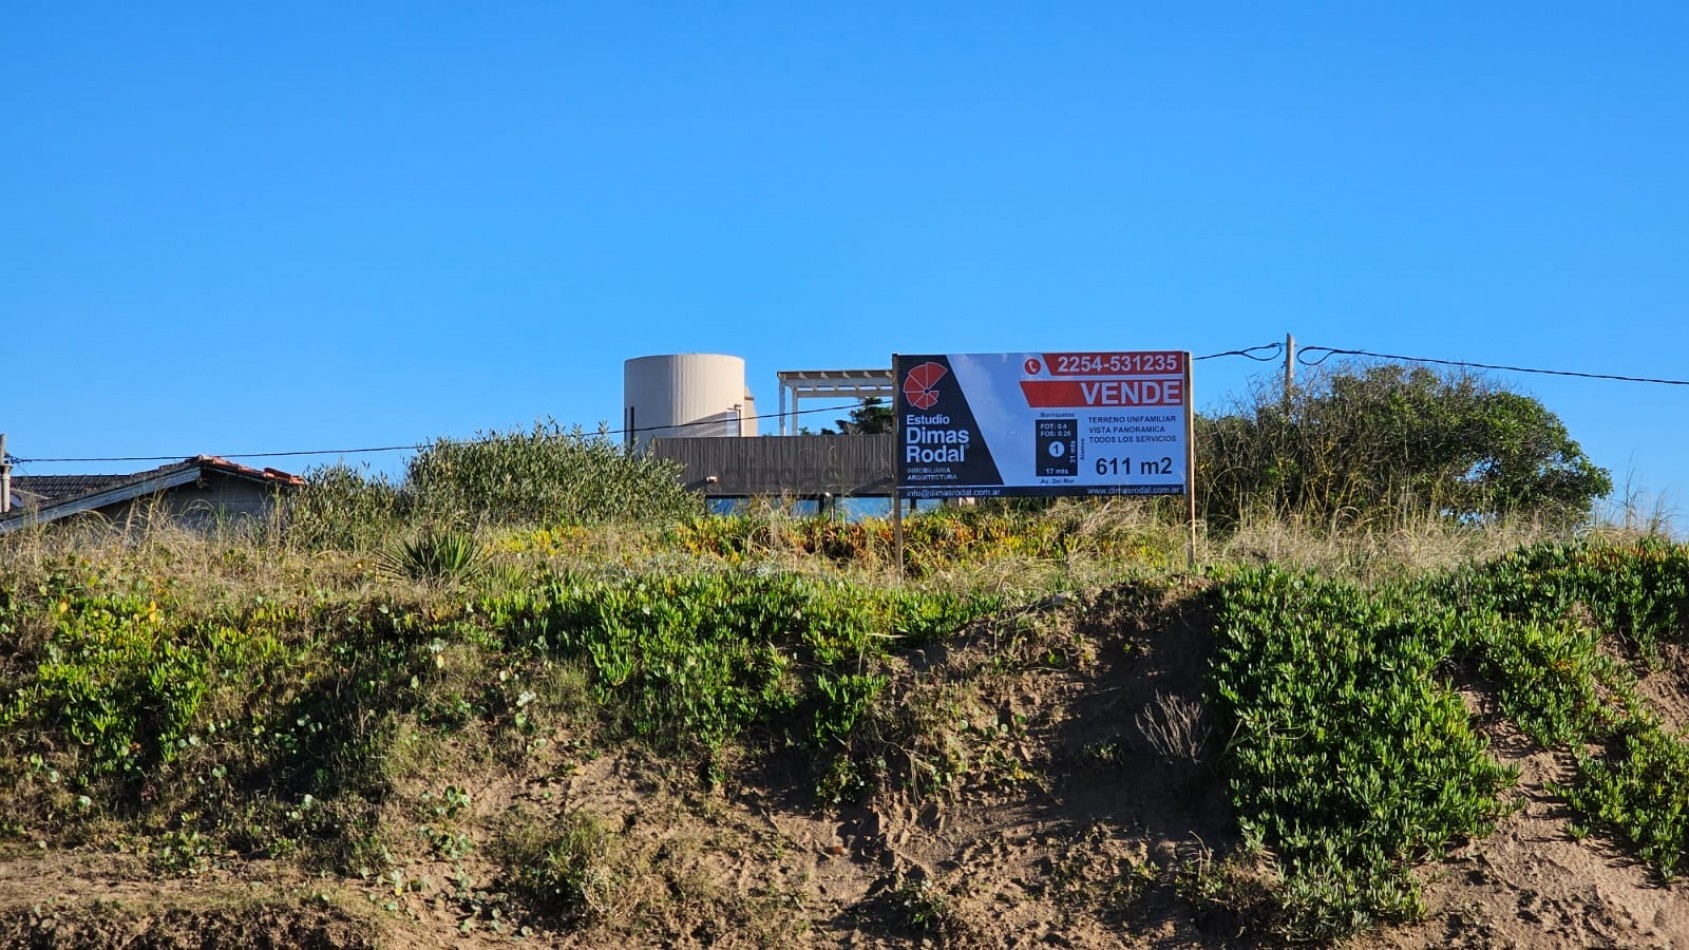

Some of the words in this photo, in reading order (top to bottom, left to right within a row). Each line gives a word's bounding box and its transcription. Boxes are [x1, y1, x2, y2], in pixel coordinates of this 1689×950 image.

[1058, 355, 1177, 372] 2254-531235
[1080, 381, 1181, 404] VENDE
[906, 414, 950, 425] Estudio
[1127, 415, 1176, 423] UNIFAMILIAR
[906, 426, 970, 444] Dimas
[906, 445, 965, 463] Rodal
[1053, 444, 1060, 454] 1
[1096, 457, 1131, 475] 611
[1140, 457, 1173, 475] m2
[906, 489, 1001, 498] info@dimasrodal.com.ar
[1087, 487, 1180, 495] www.dimasrodal.com.ar
